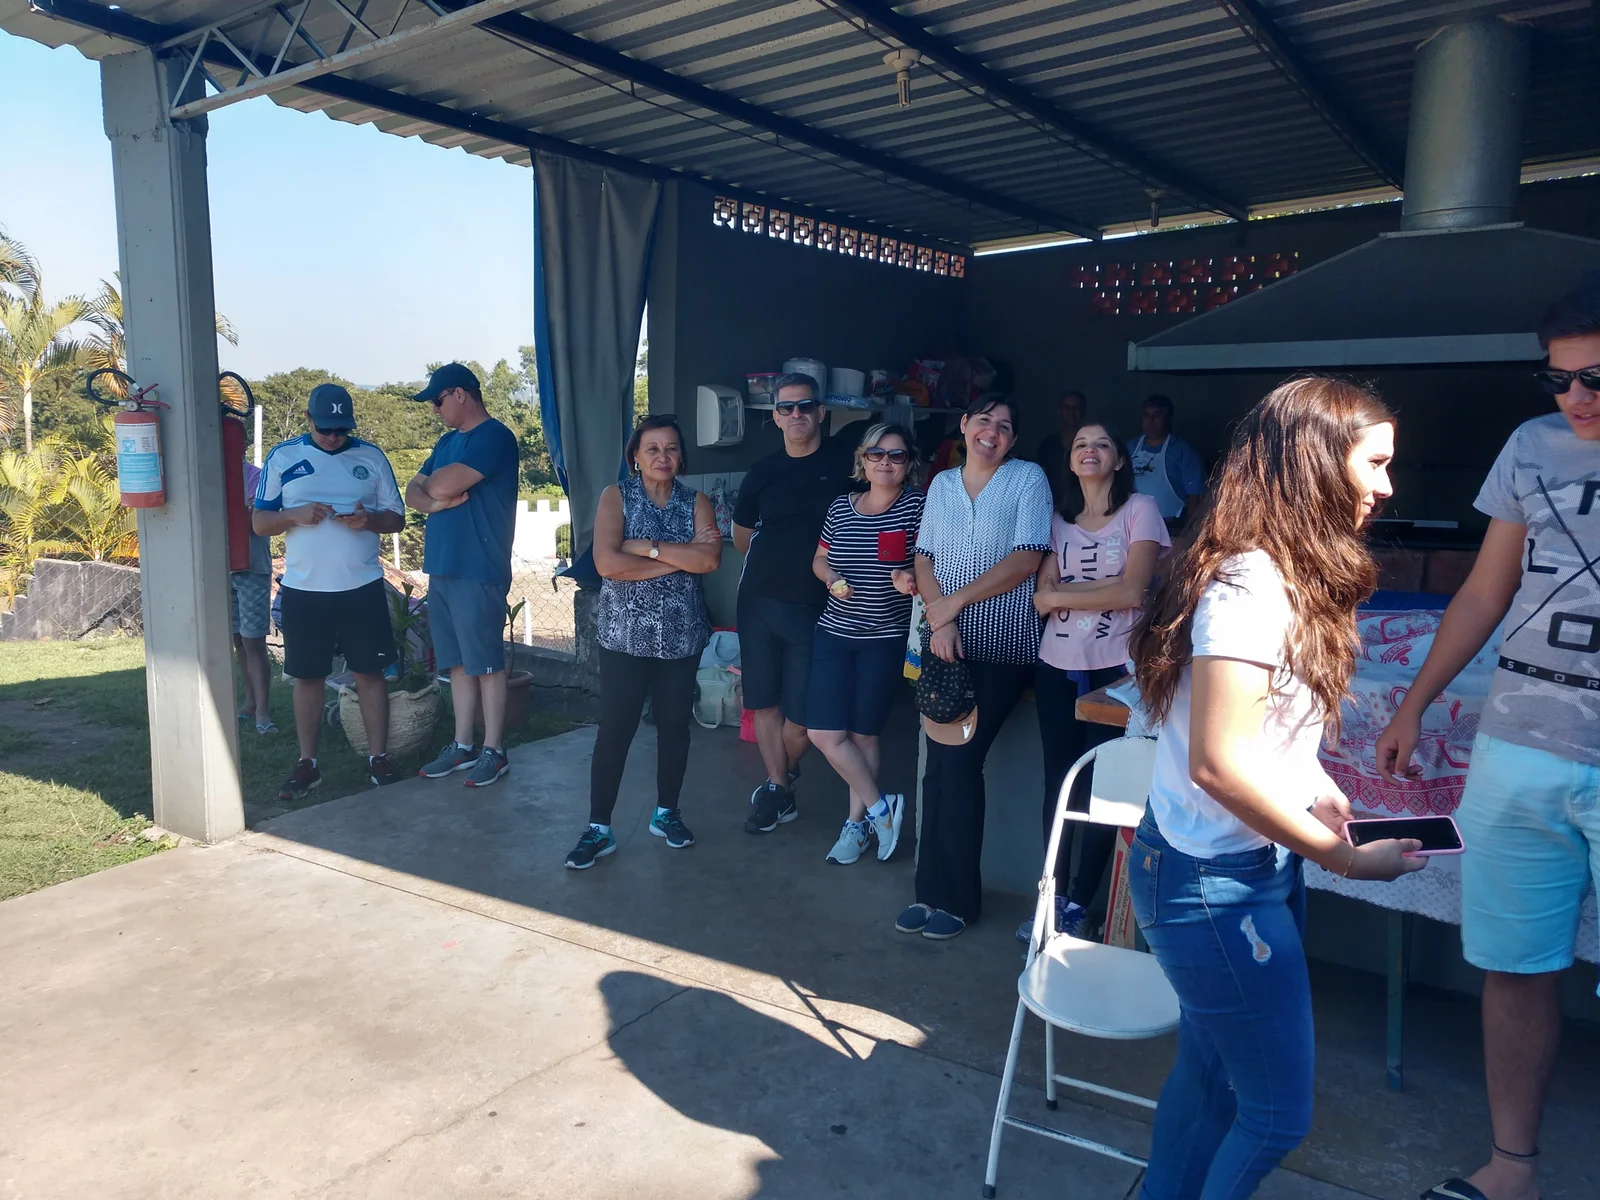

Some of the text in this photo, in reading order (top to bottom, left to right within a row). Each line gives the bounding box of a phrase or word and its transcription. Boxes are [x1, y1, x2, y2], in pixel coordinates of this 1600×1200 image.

[1105, 536, 1122, 565] ME
[1076, 542, 1099, 631] & ILL
